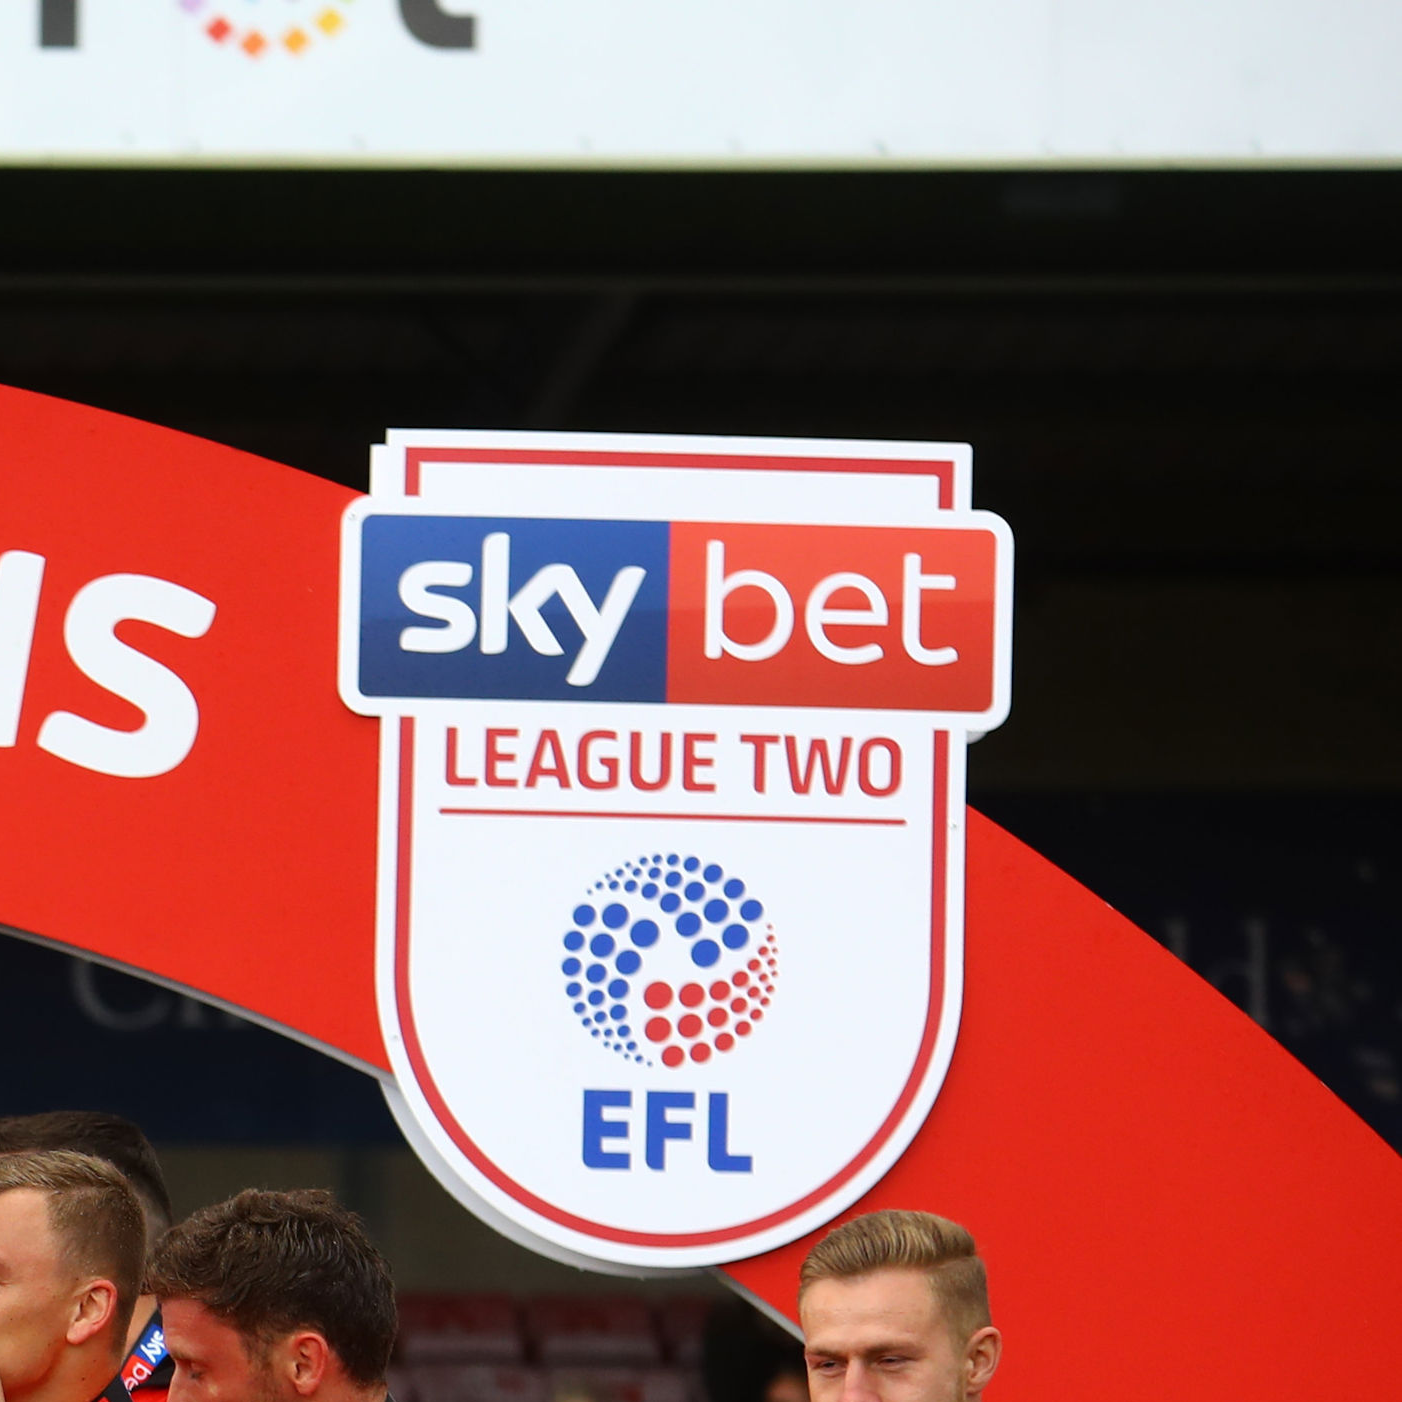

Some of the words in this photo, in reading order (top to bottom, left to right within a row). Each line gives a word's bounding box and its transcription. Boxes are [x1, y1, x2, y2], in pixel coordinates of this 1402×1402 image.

[399, 532, 646, 686] sky
[705, 540, 958, 665] bet
[445, 727, 717, 793] LEAGUE
[741, 733, 903, 798] TWO
[581, 1088, 753, 1174] EFL
